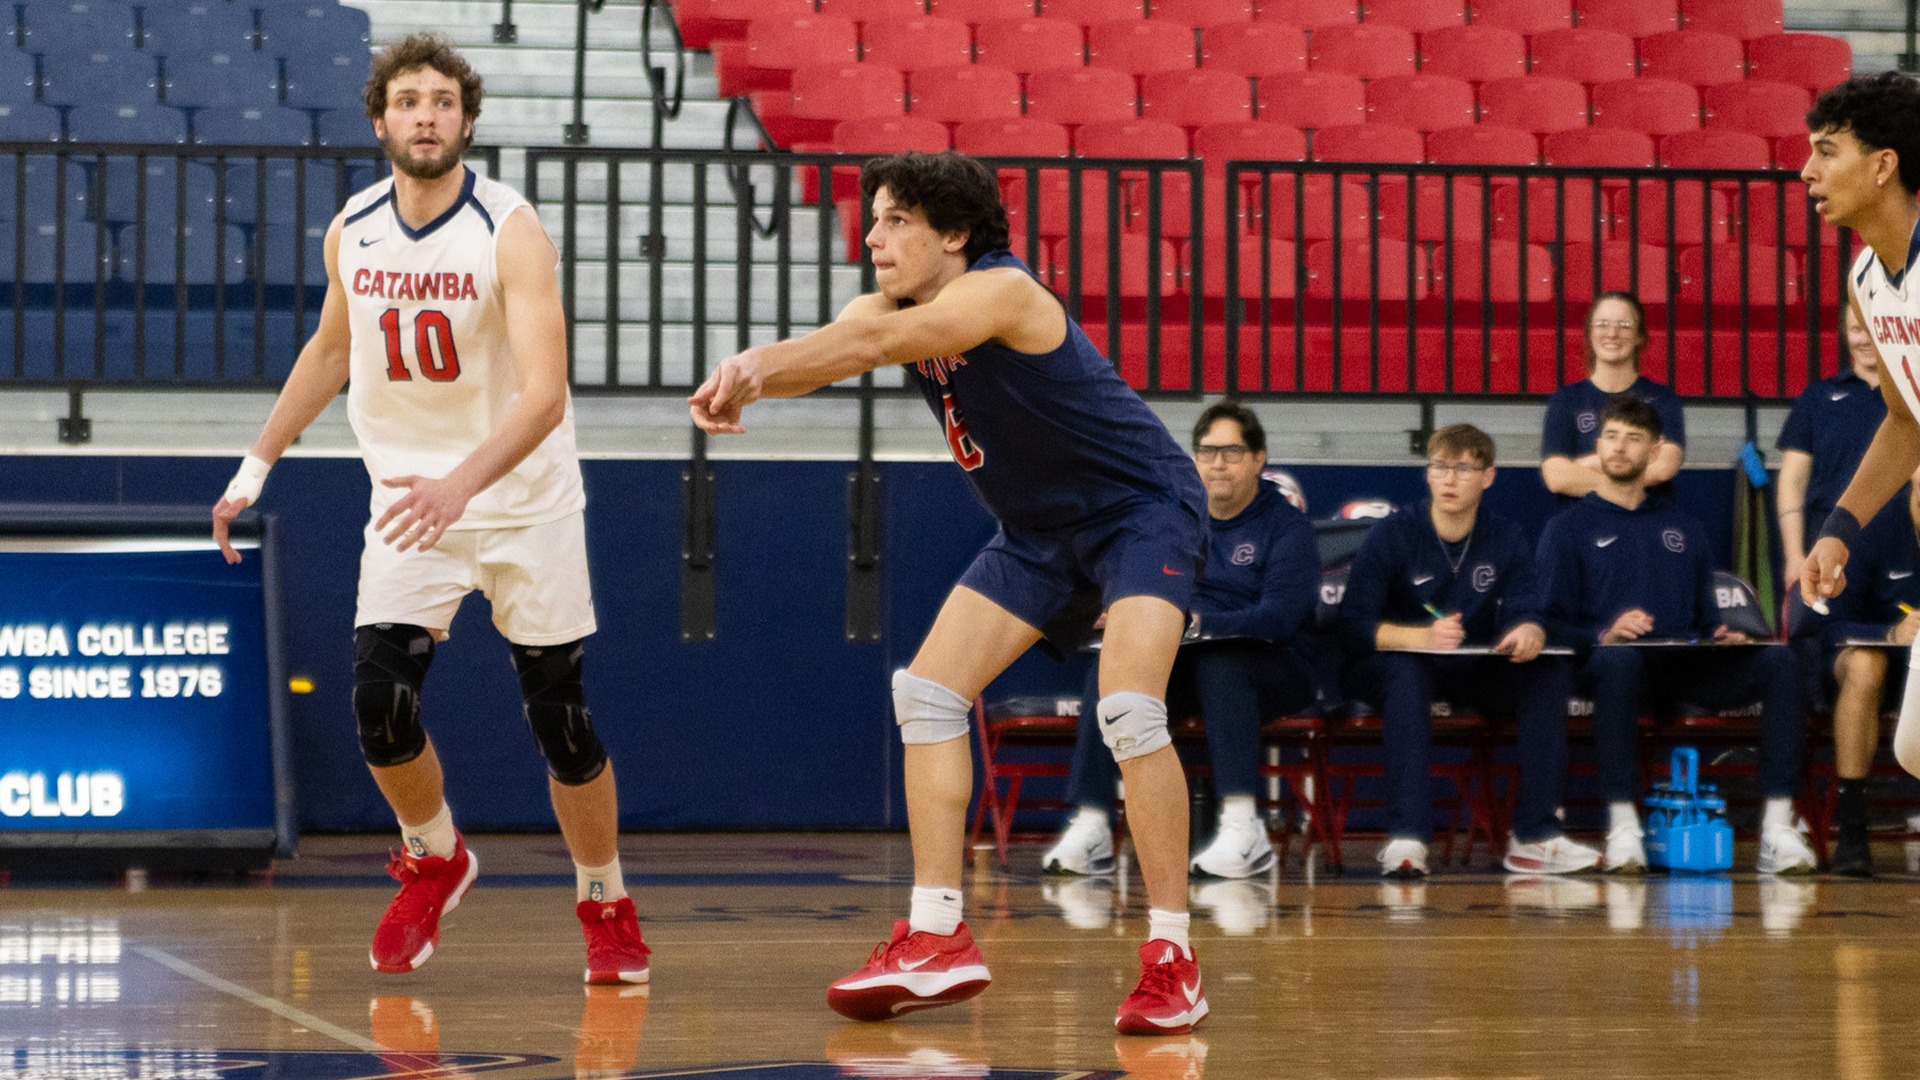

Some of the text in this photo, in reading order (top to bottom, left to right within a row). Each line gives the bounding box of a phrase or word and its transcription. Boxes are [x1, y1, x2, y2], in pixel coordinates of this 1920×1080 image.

[352, 268, 478, 300] CATAWBA
[379, 308, 461, 382] 10
[77, 622, 230, 657] COLLEGE
[29, 666, 132, 699] SINCE
[140, 665, 223, 698] 1976
[0, 773, 124, 817] CLUB
